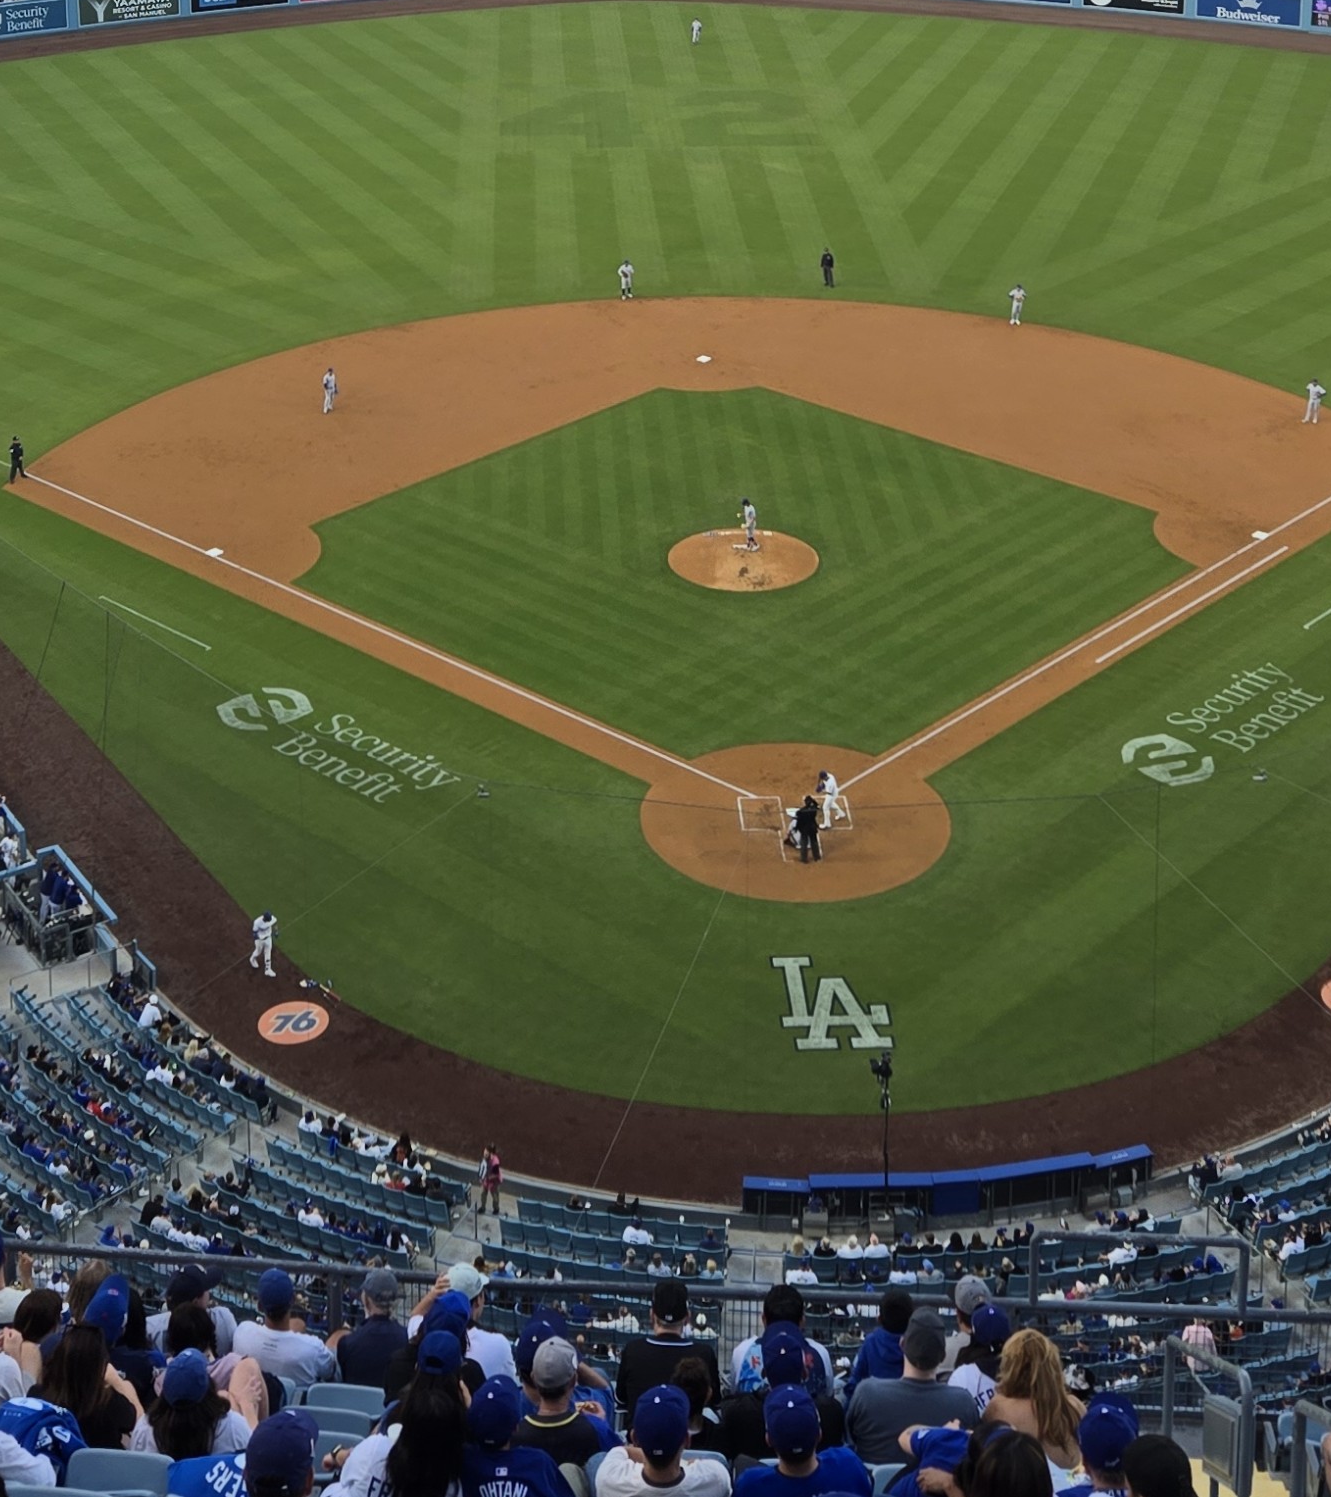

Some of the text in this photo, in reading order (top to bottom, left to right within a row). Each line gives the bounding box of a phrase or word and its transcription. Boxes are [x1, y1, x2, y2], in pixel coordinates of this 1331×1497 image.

[5, 6, 49, 21] Security
[113, 5, 140, 14] RESORT
[146, 2, 172, 11] CASINO
[139, 9, 166, 18] MANUEL
[1216, 6, 1280, 24] Budweiser
[7, 17, 44, 33] Benefit
[1165, 662, 1295, 734] Security
[1208, 686, 1325, 754] Benefit
[313, 713, 462, 790] Security
[272, 730, 404, 804] Benefit
[771, 955, 893, 1051] LA
[271, 1010, 319, 1034] 76
